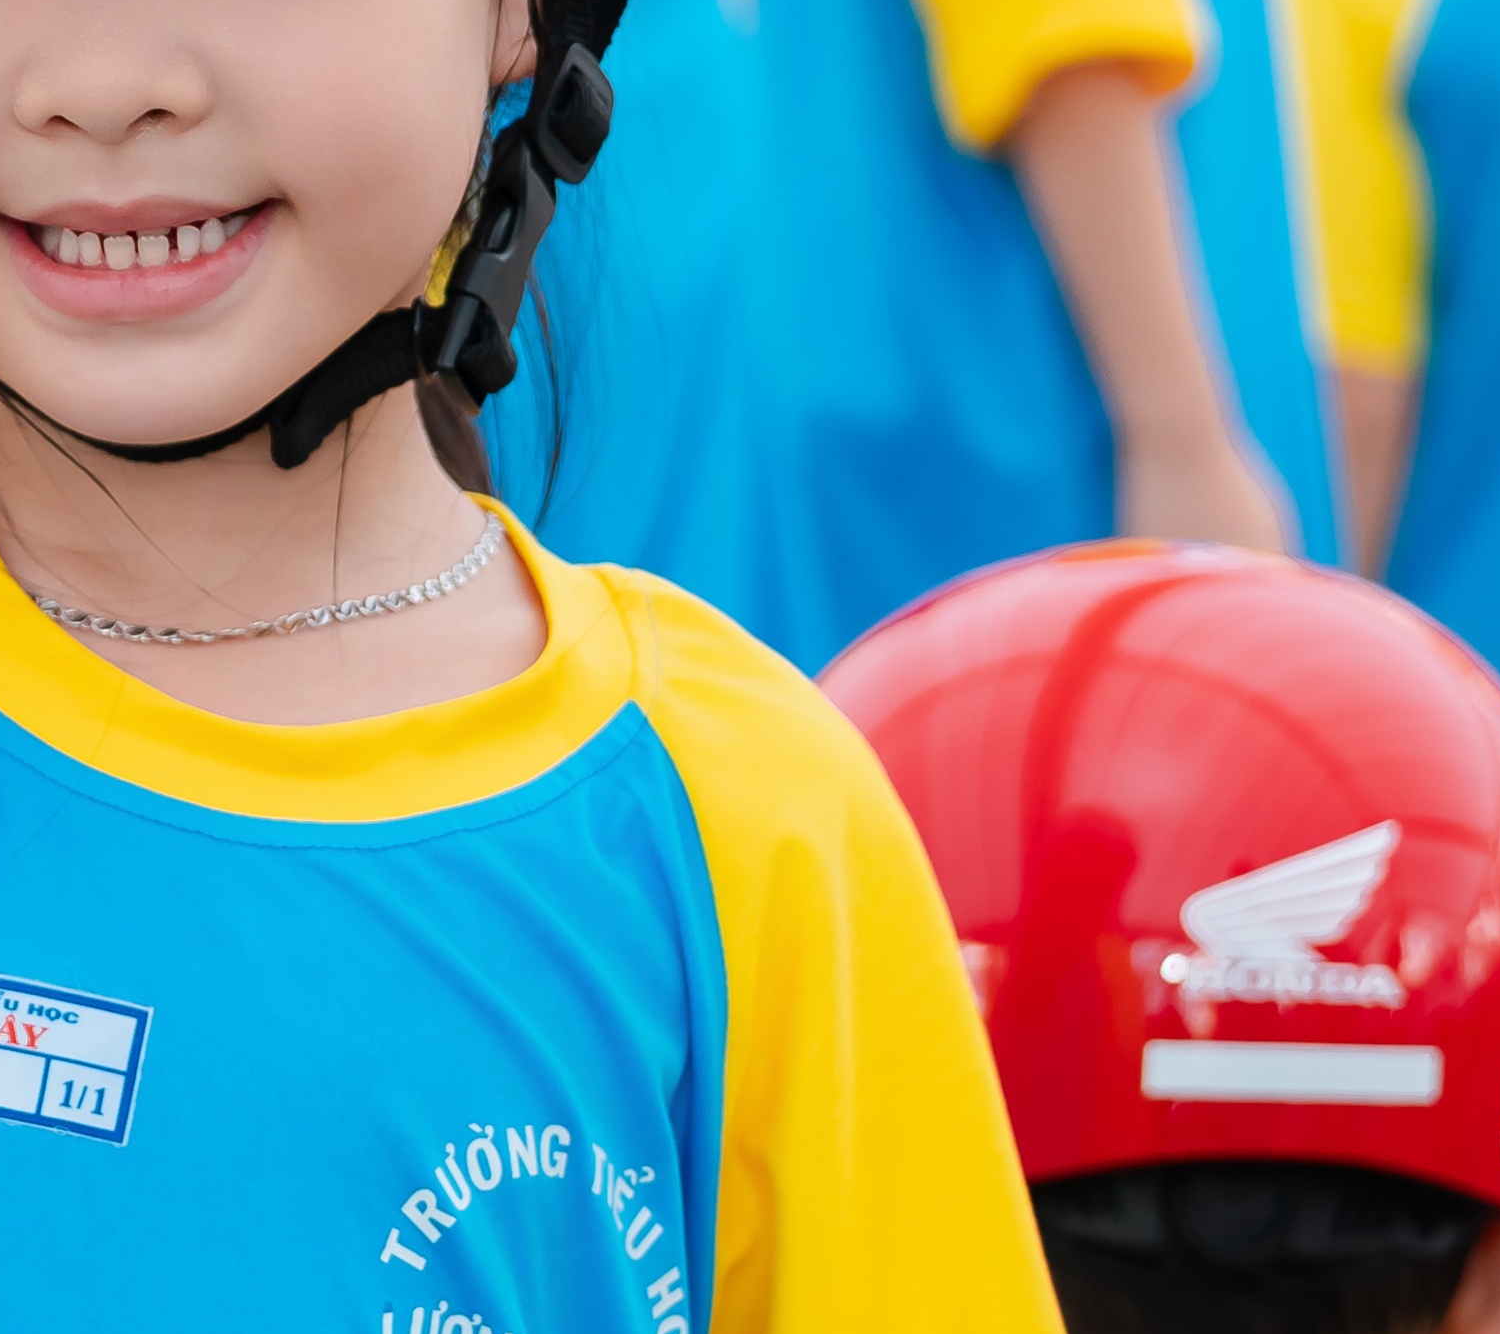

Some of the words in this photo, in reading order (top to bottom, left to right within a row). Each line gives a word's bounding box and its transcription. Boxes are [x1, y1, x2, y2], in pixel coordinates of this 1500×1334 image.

[1185, 961, 1406, 1008] HONDA
[27, 1002, 81, 1026] HỌC
[58, 1079, 106, 1117] 1/1
[379, 1122, 571, 1271] TRƯỜNG
[590, 1142, 665, 1261] TIỂU
